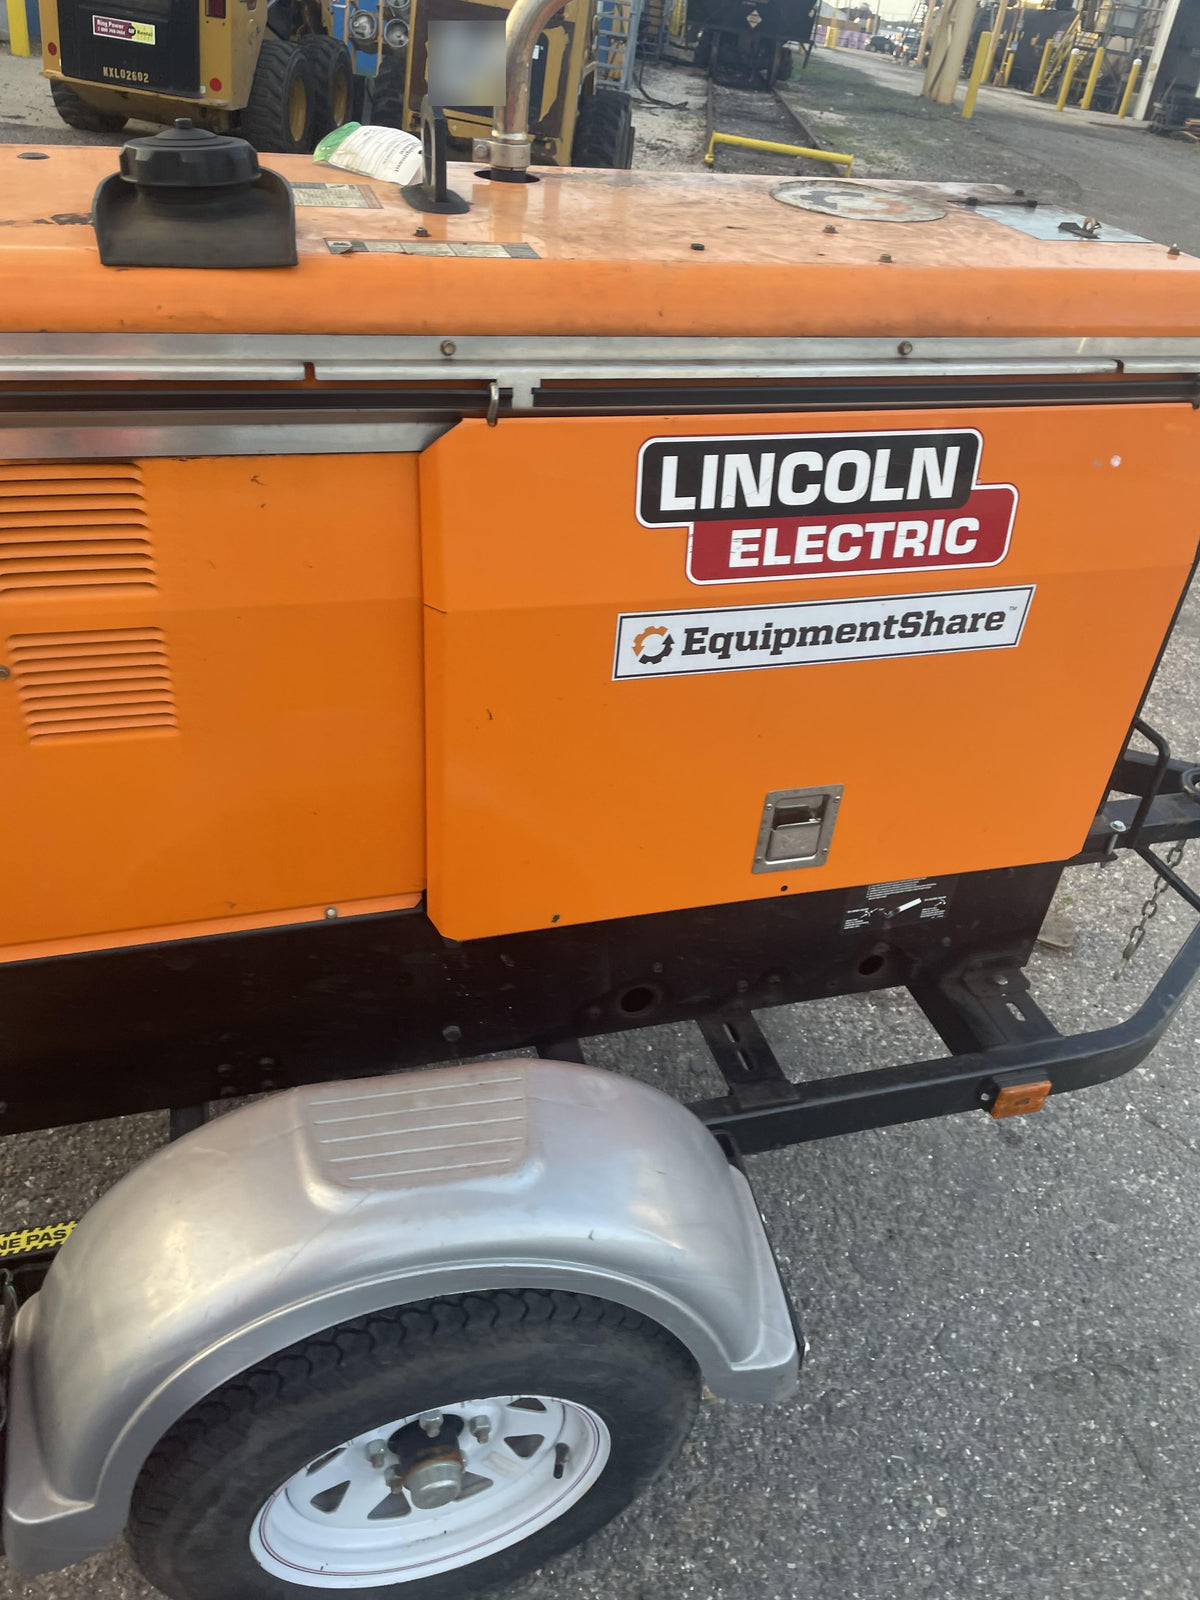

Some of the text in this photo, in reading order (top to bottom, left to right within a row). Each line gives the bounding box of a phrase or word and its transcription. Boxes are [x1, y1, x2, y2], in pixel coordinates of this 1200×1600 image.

[659, 446, 961, 512] LINCOLN
[729, 517, 980, 568] ELECTRIC
[681, 610, 1006, 660] EquipmentShare
[26, 1229, 67, 1245] PAS
